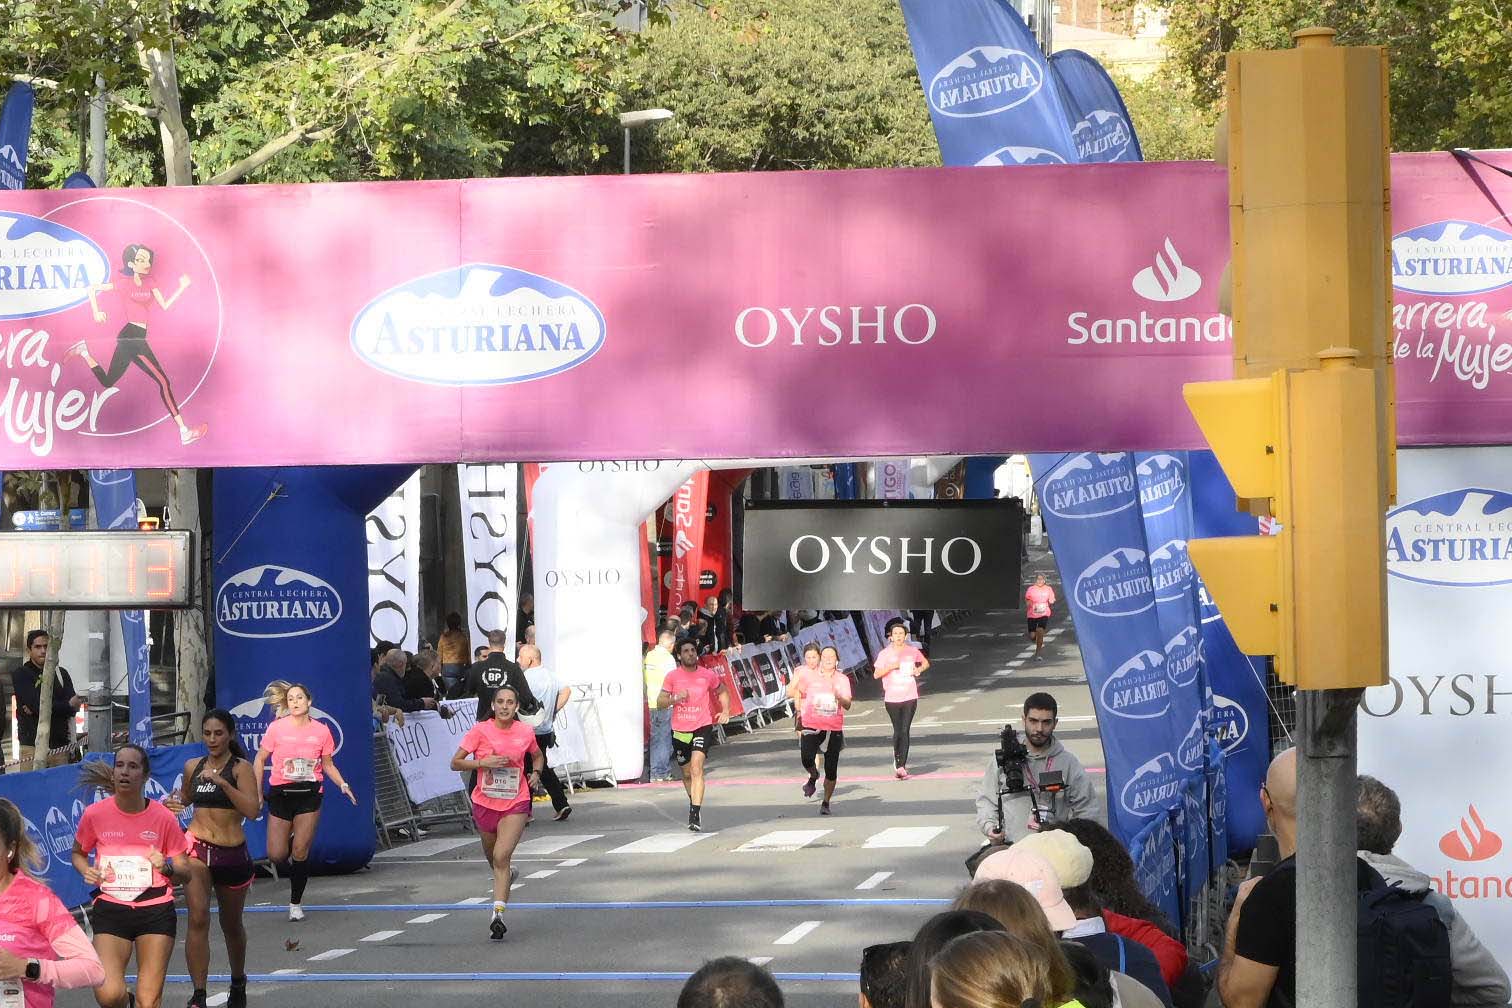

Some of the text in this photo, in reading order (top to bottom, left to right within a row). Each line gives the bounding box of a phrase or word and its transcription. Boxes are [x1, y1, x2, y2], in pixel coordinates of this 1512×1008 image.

[1463, 245, 1512, 254] LECHER
[735, 303, 937, 349] OYSHO
[1067, 311, 1233, 346] Santand
[1392, 301, 1488, 330] arrera
[372, 311, 585, 354] ASTURIANA
[1417, 330, 1434, 358] la
[1430, 325, 1512, 390] Muje
[1414, 522, 1481, 533] CENTRAL
[789, 534, 982, 576] OYSHO
[220, 594, 333, 622] ASTURIANA
[232, 589, 328, 599] CENTRAL LECHERA
[488, 673, 501, 681] BP
[1359, 674, 1512, 718] OYSH
[196, 781, 216, 795] nike
